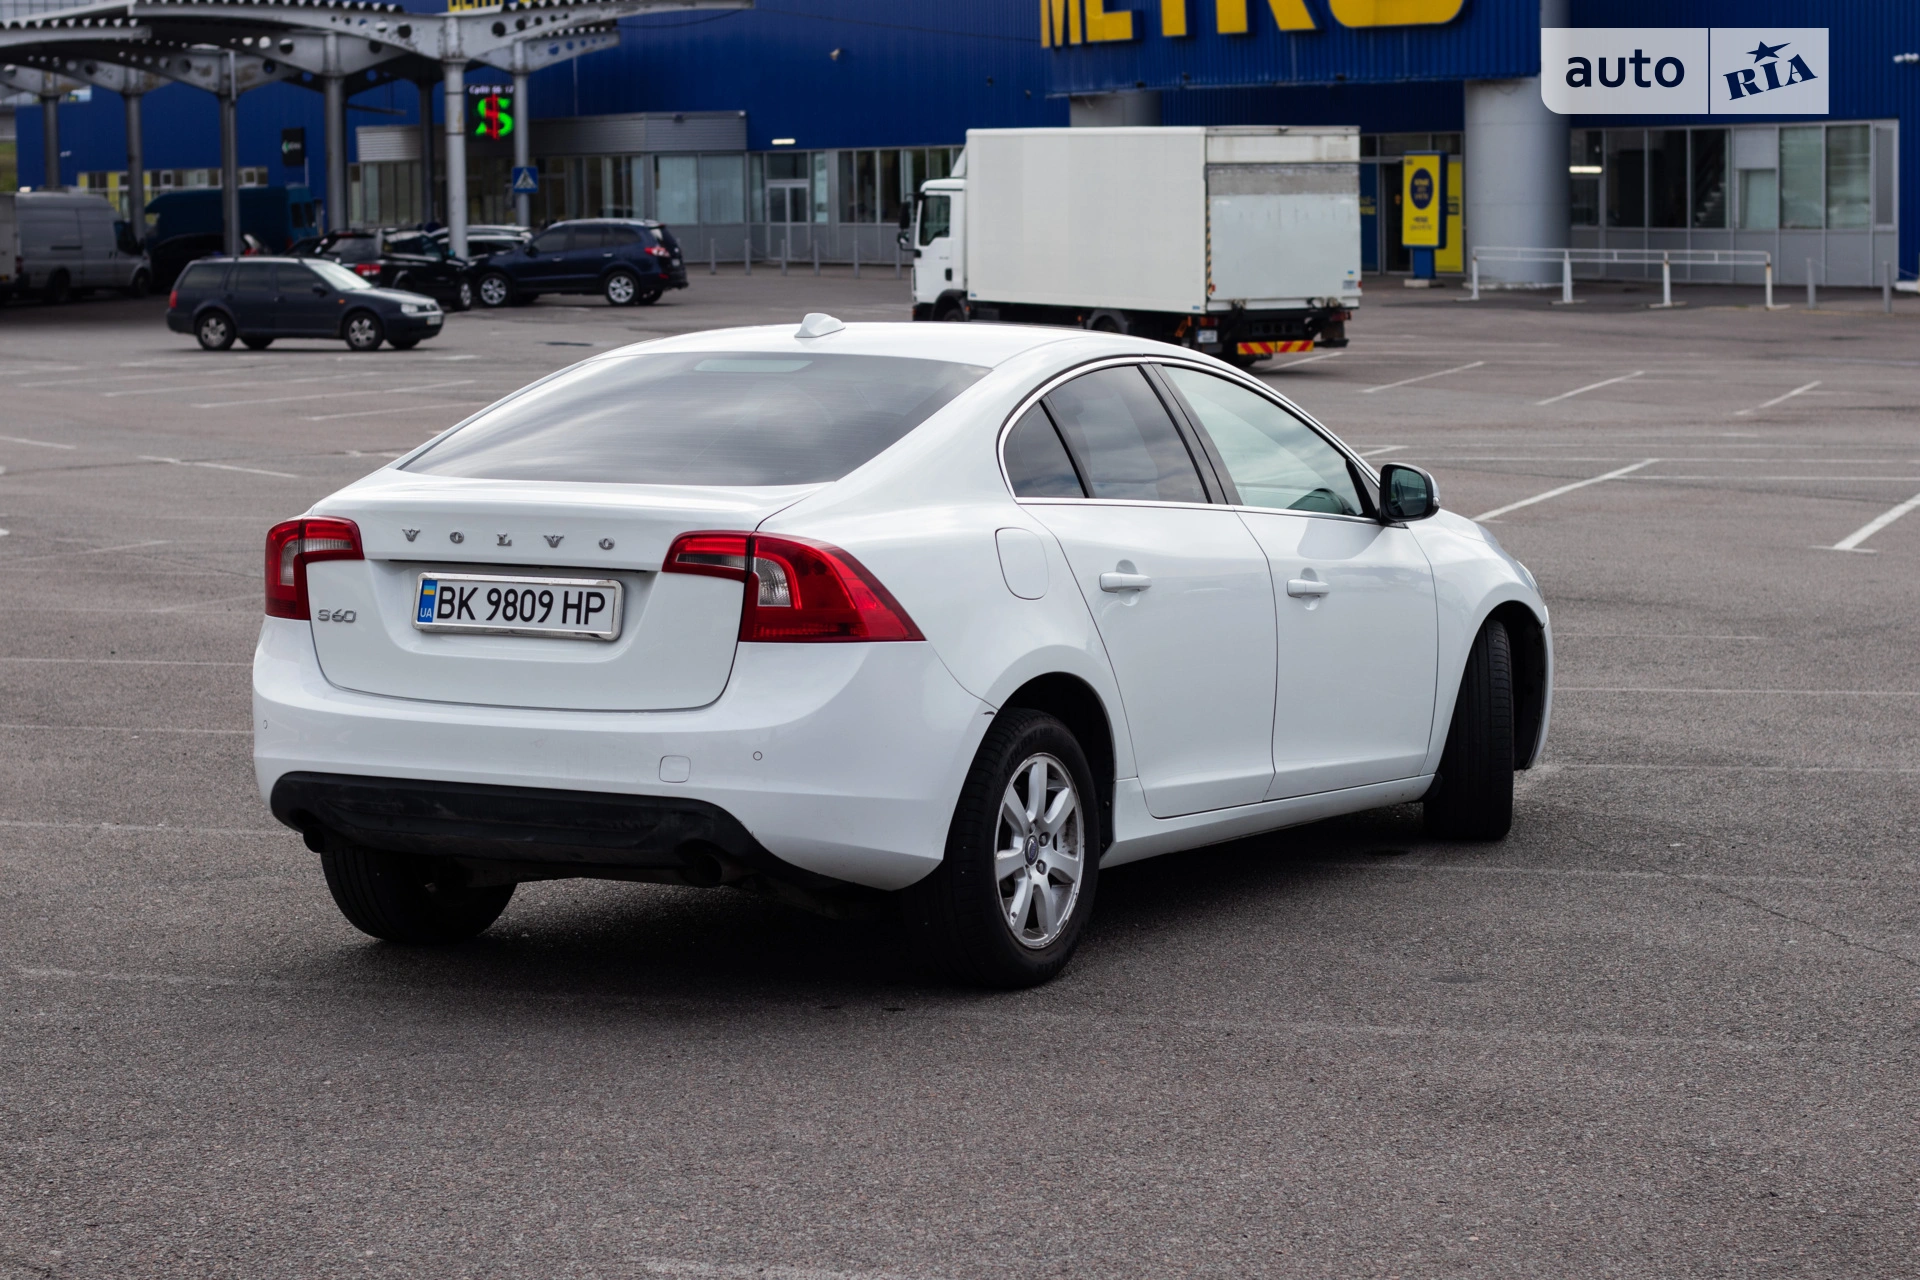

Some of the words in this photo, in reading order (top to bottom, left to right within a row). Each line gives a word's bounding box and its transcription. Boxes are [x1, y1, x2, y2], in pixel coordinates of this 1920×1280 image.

[402, 528, 615, 550] VOLVO
[420, 608, 432, 618] UA
[436, 586, 479, 621] BK
[485, 587, 554, 623] 9809
[562, 590, 606, 625] HP
[317, 609, 356, 623] S60
